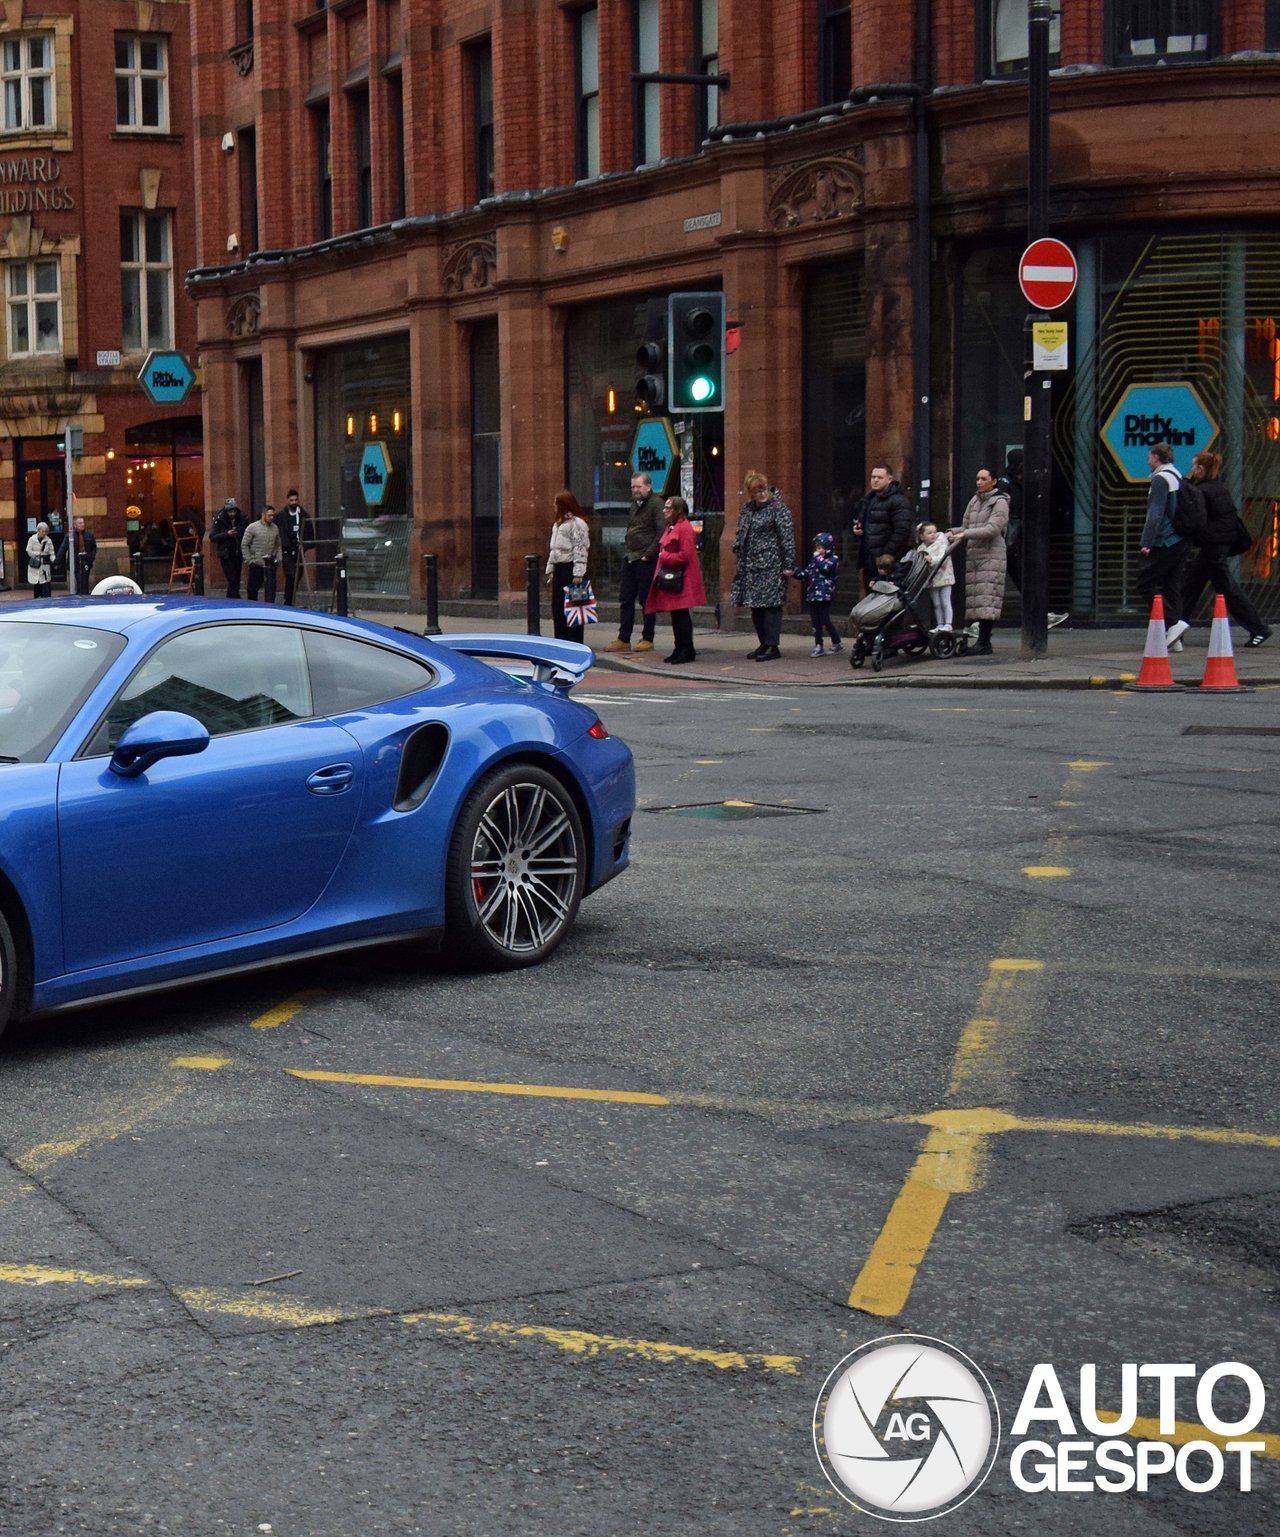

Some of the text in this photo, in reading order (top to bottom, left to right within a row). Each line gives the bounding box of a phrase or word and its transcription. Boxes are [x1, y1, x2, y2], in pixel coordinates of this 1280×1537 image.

[684, 213, 720, 231] DEANSGATE
[153, 371, 173, 381] Dirty
[153, 377, 184, 387] martini
[1124, 414, 1173, 434] Dirty
[1124, 428, 1195, 446] martini
[638, 447, 657, 460] Dirty
[364, 464, 377, 477] Dirty
[638, 457, 666, 471] martini
